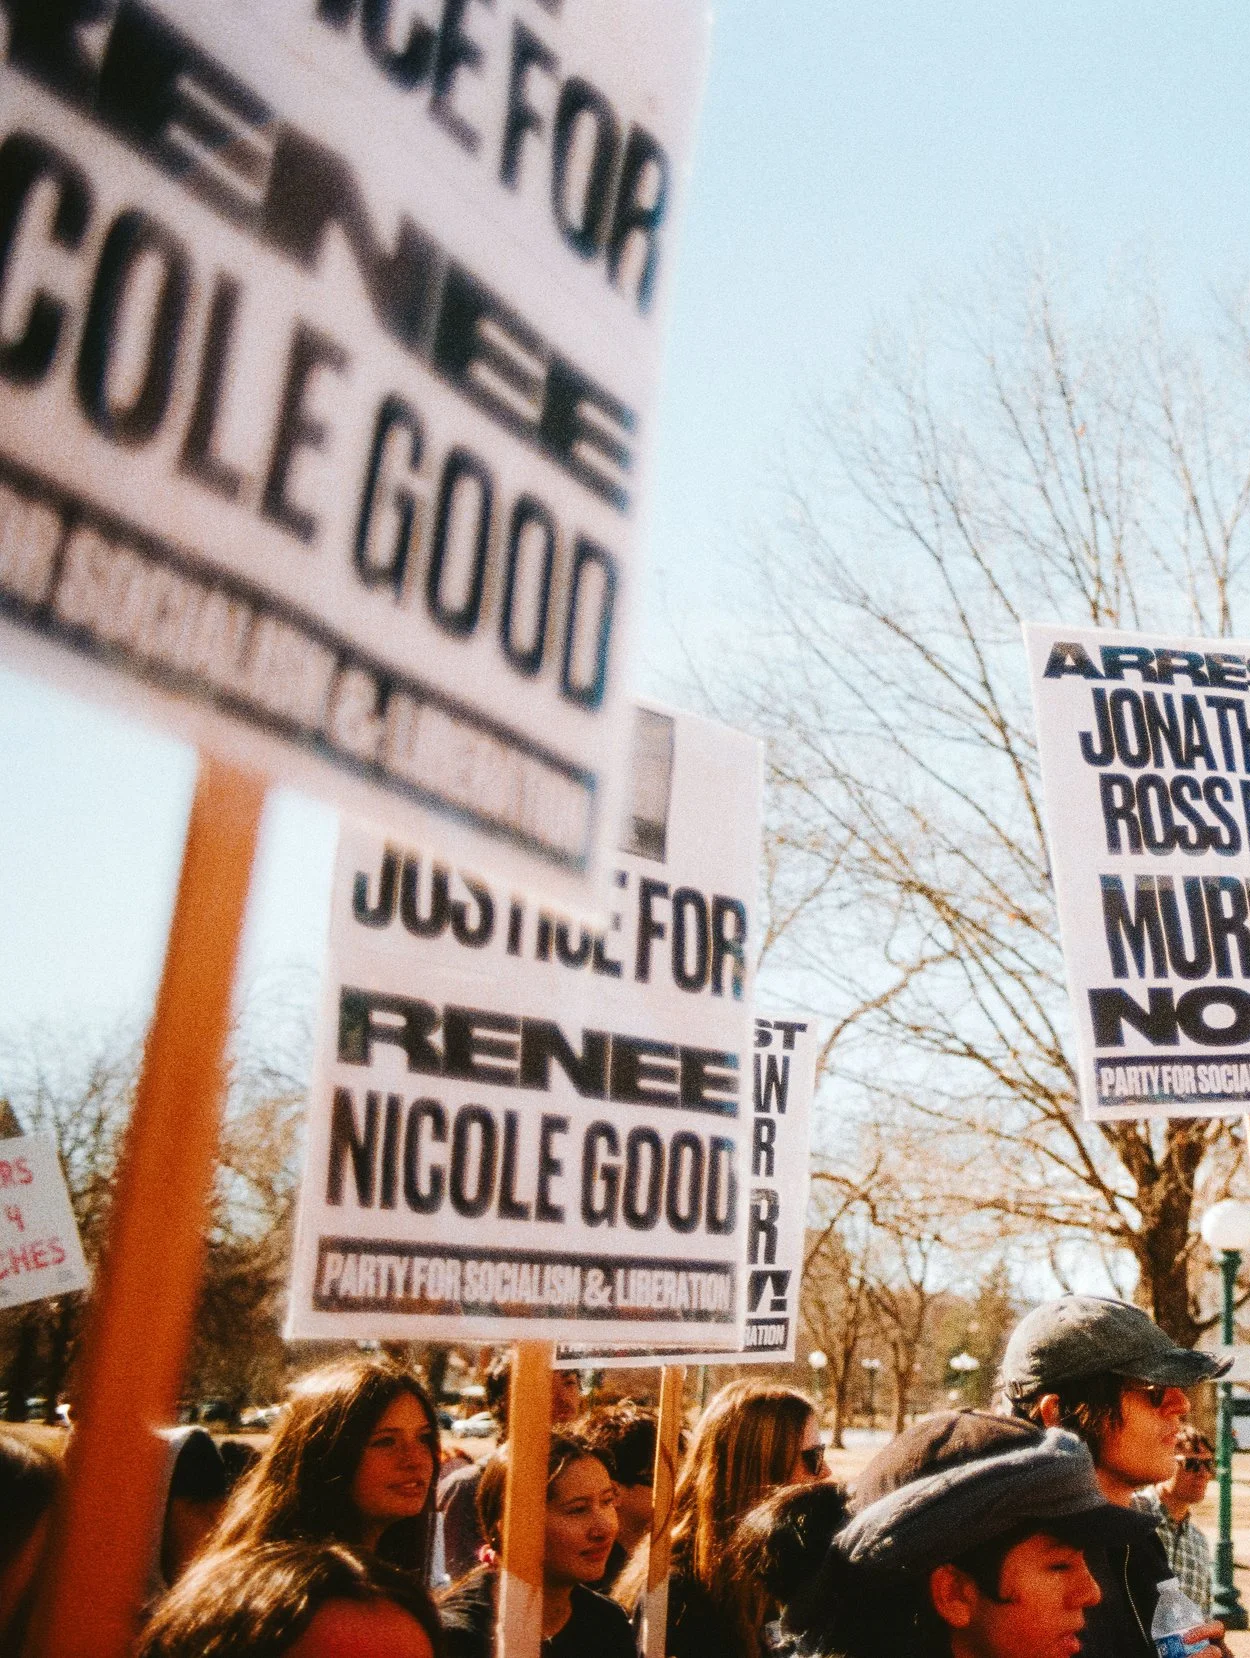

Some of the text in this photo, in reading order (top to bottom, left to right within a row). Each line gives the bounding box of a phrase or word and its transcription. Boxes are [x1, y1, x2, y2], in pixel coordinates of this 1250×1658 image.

[497, 18, 672, 313] FOR
[352, 392, 621, 710] GOOD
[1100, 772, 1243, 858] ROSS
[634, 875, 749, 1000] FOR
[337, 984, 739, 1118] RENEE
[1100, 1064, 1162, 1098] PARTY
[1161, 1066, 1198, 1096] FOR
[326, 1086, 571, 1225] NICOLE
[582, 1119, 738, 1237] GOOD
[321, 1250, 410, 1298] PARTY
[413, 1256, 461, 1298] FOR
[464, 1259, 582, 1305] SOCIALISM
[584, 1267, 614, 1308] &
[616, 1266, 732, 1310] LIBERATION
